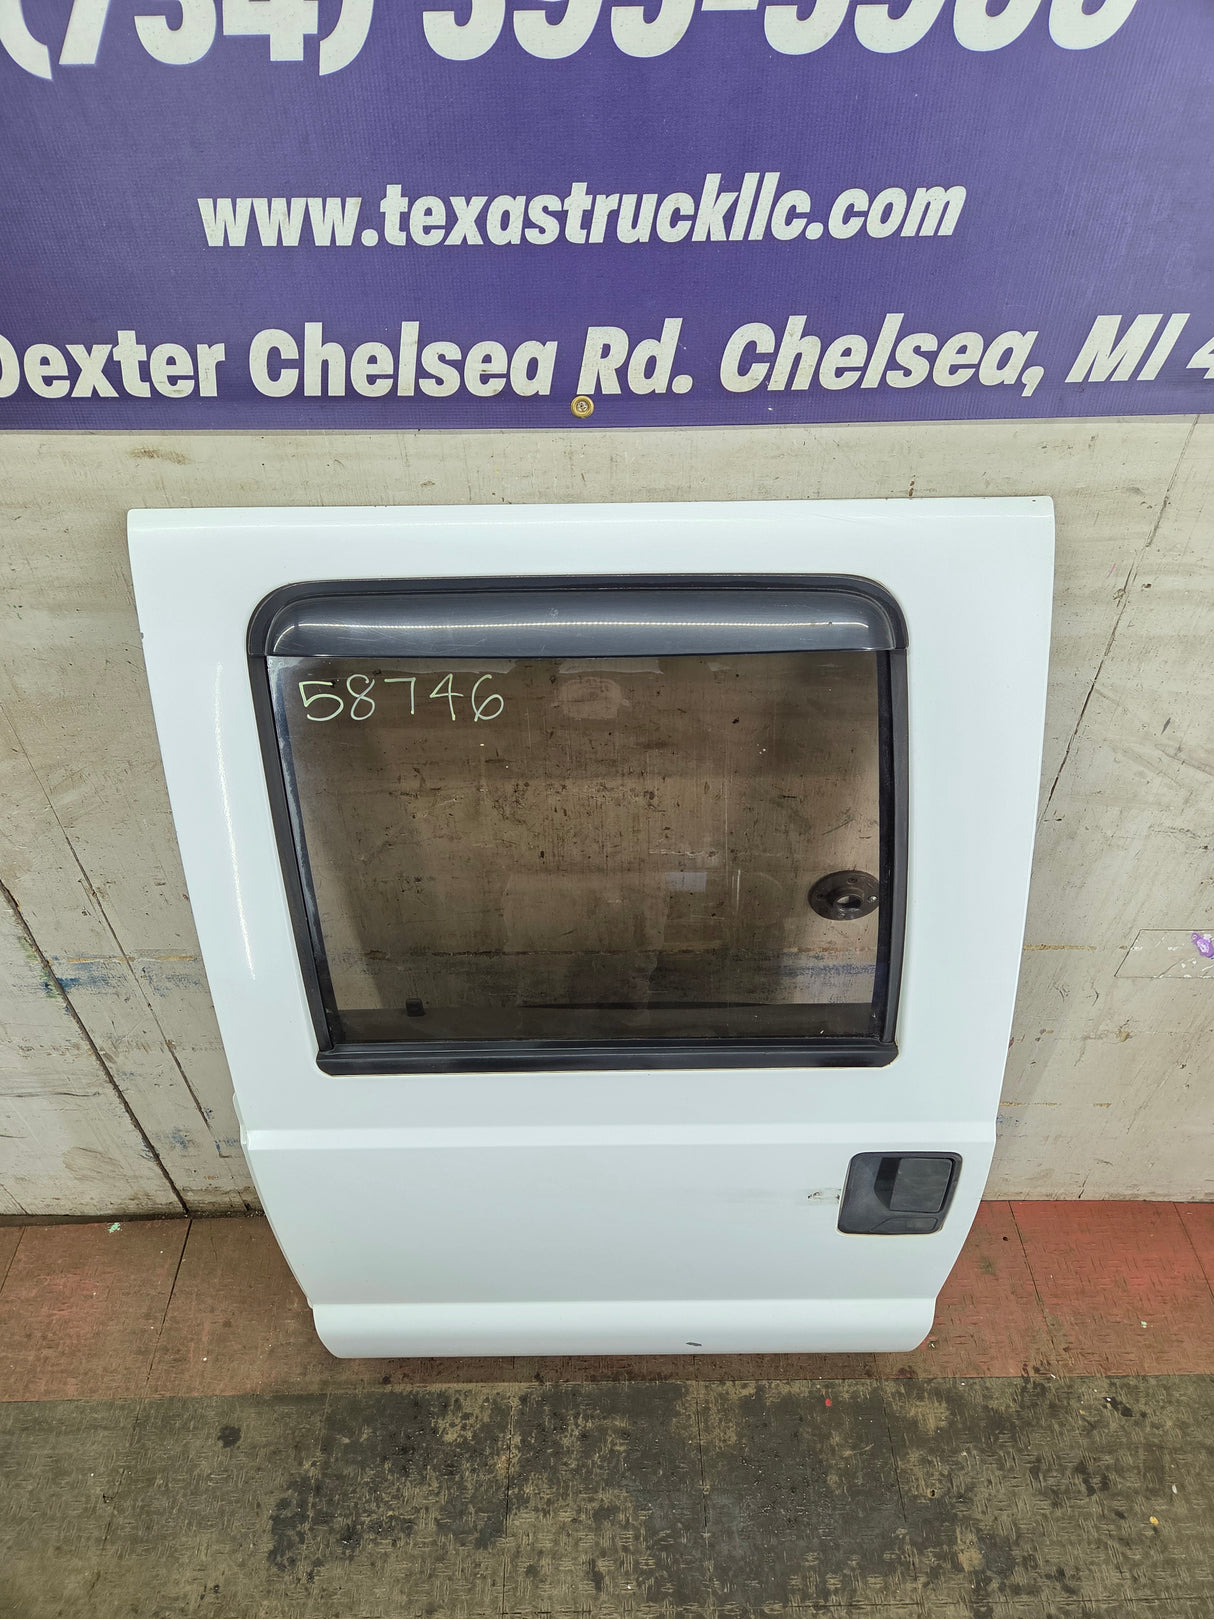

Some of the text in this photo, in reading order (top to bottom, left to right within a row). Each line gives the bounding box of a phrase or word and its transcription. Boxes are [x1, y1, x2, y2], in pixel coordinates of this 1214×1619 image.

[197, 171, 967, 247] www.texastruckllc.com
[250, 320, 558, 398] Chelsea
[577, 317, 693, 395] Rd.
[720, 312, 1045, 397] Chelsea,
[1064, 312, 1191, 382] MI
[299, 673, 504, 722] 58746
